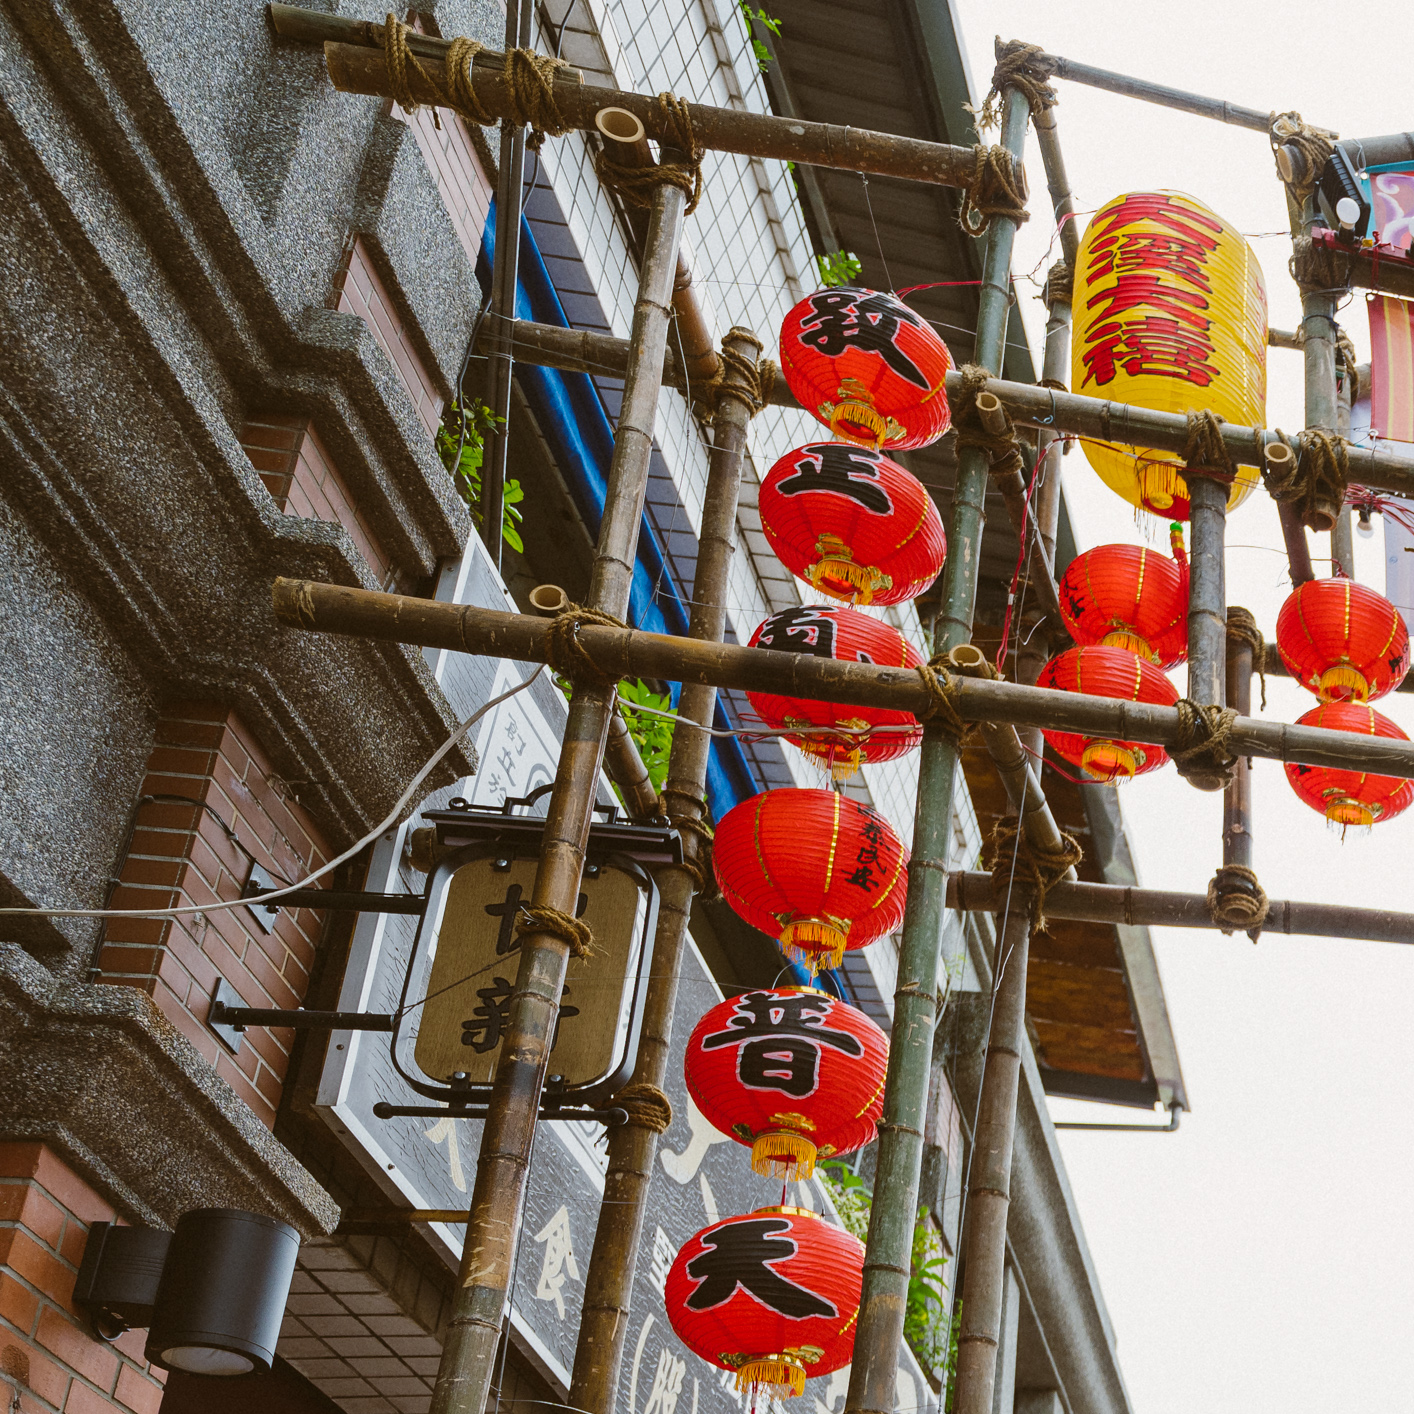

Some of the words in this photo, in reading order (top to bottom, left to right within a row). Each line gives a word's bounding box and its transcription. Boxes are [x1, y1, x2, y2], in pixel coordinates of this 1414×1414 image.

[1081, 193, 1223, 390] 大溪大禧
[686, 1218, 839, 1320] 天
